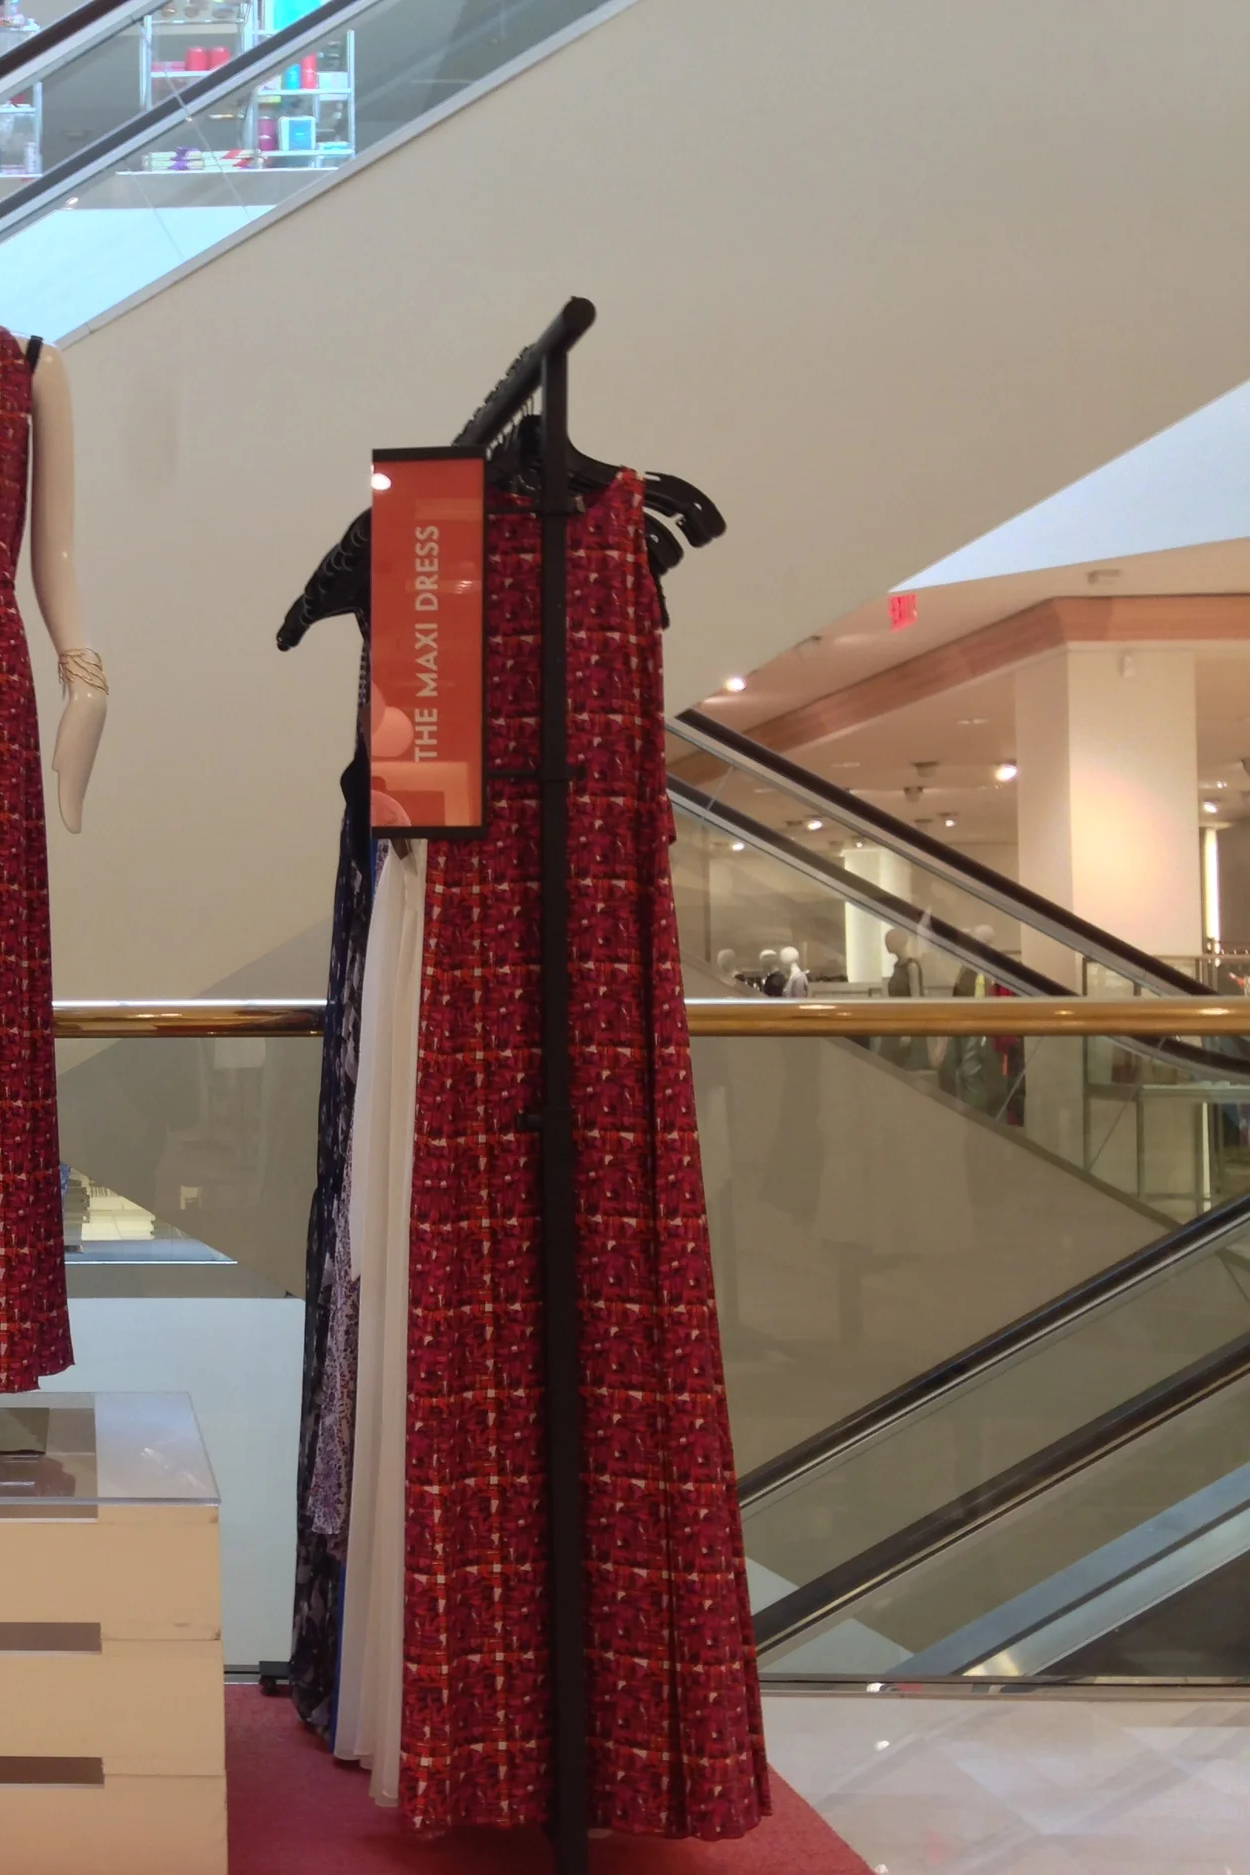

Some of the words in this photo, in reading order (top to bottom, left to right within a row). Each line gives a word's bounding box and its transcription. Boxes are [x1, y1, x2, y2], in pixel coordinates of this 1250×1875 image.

[415, 525, 439, 611] DRESS
[415, 624, 439, 698] MAXI
[414, 708, 438, 762] THE
